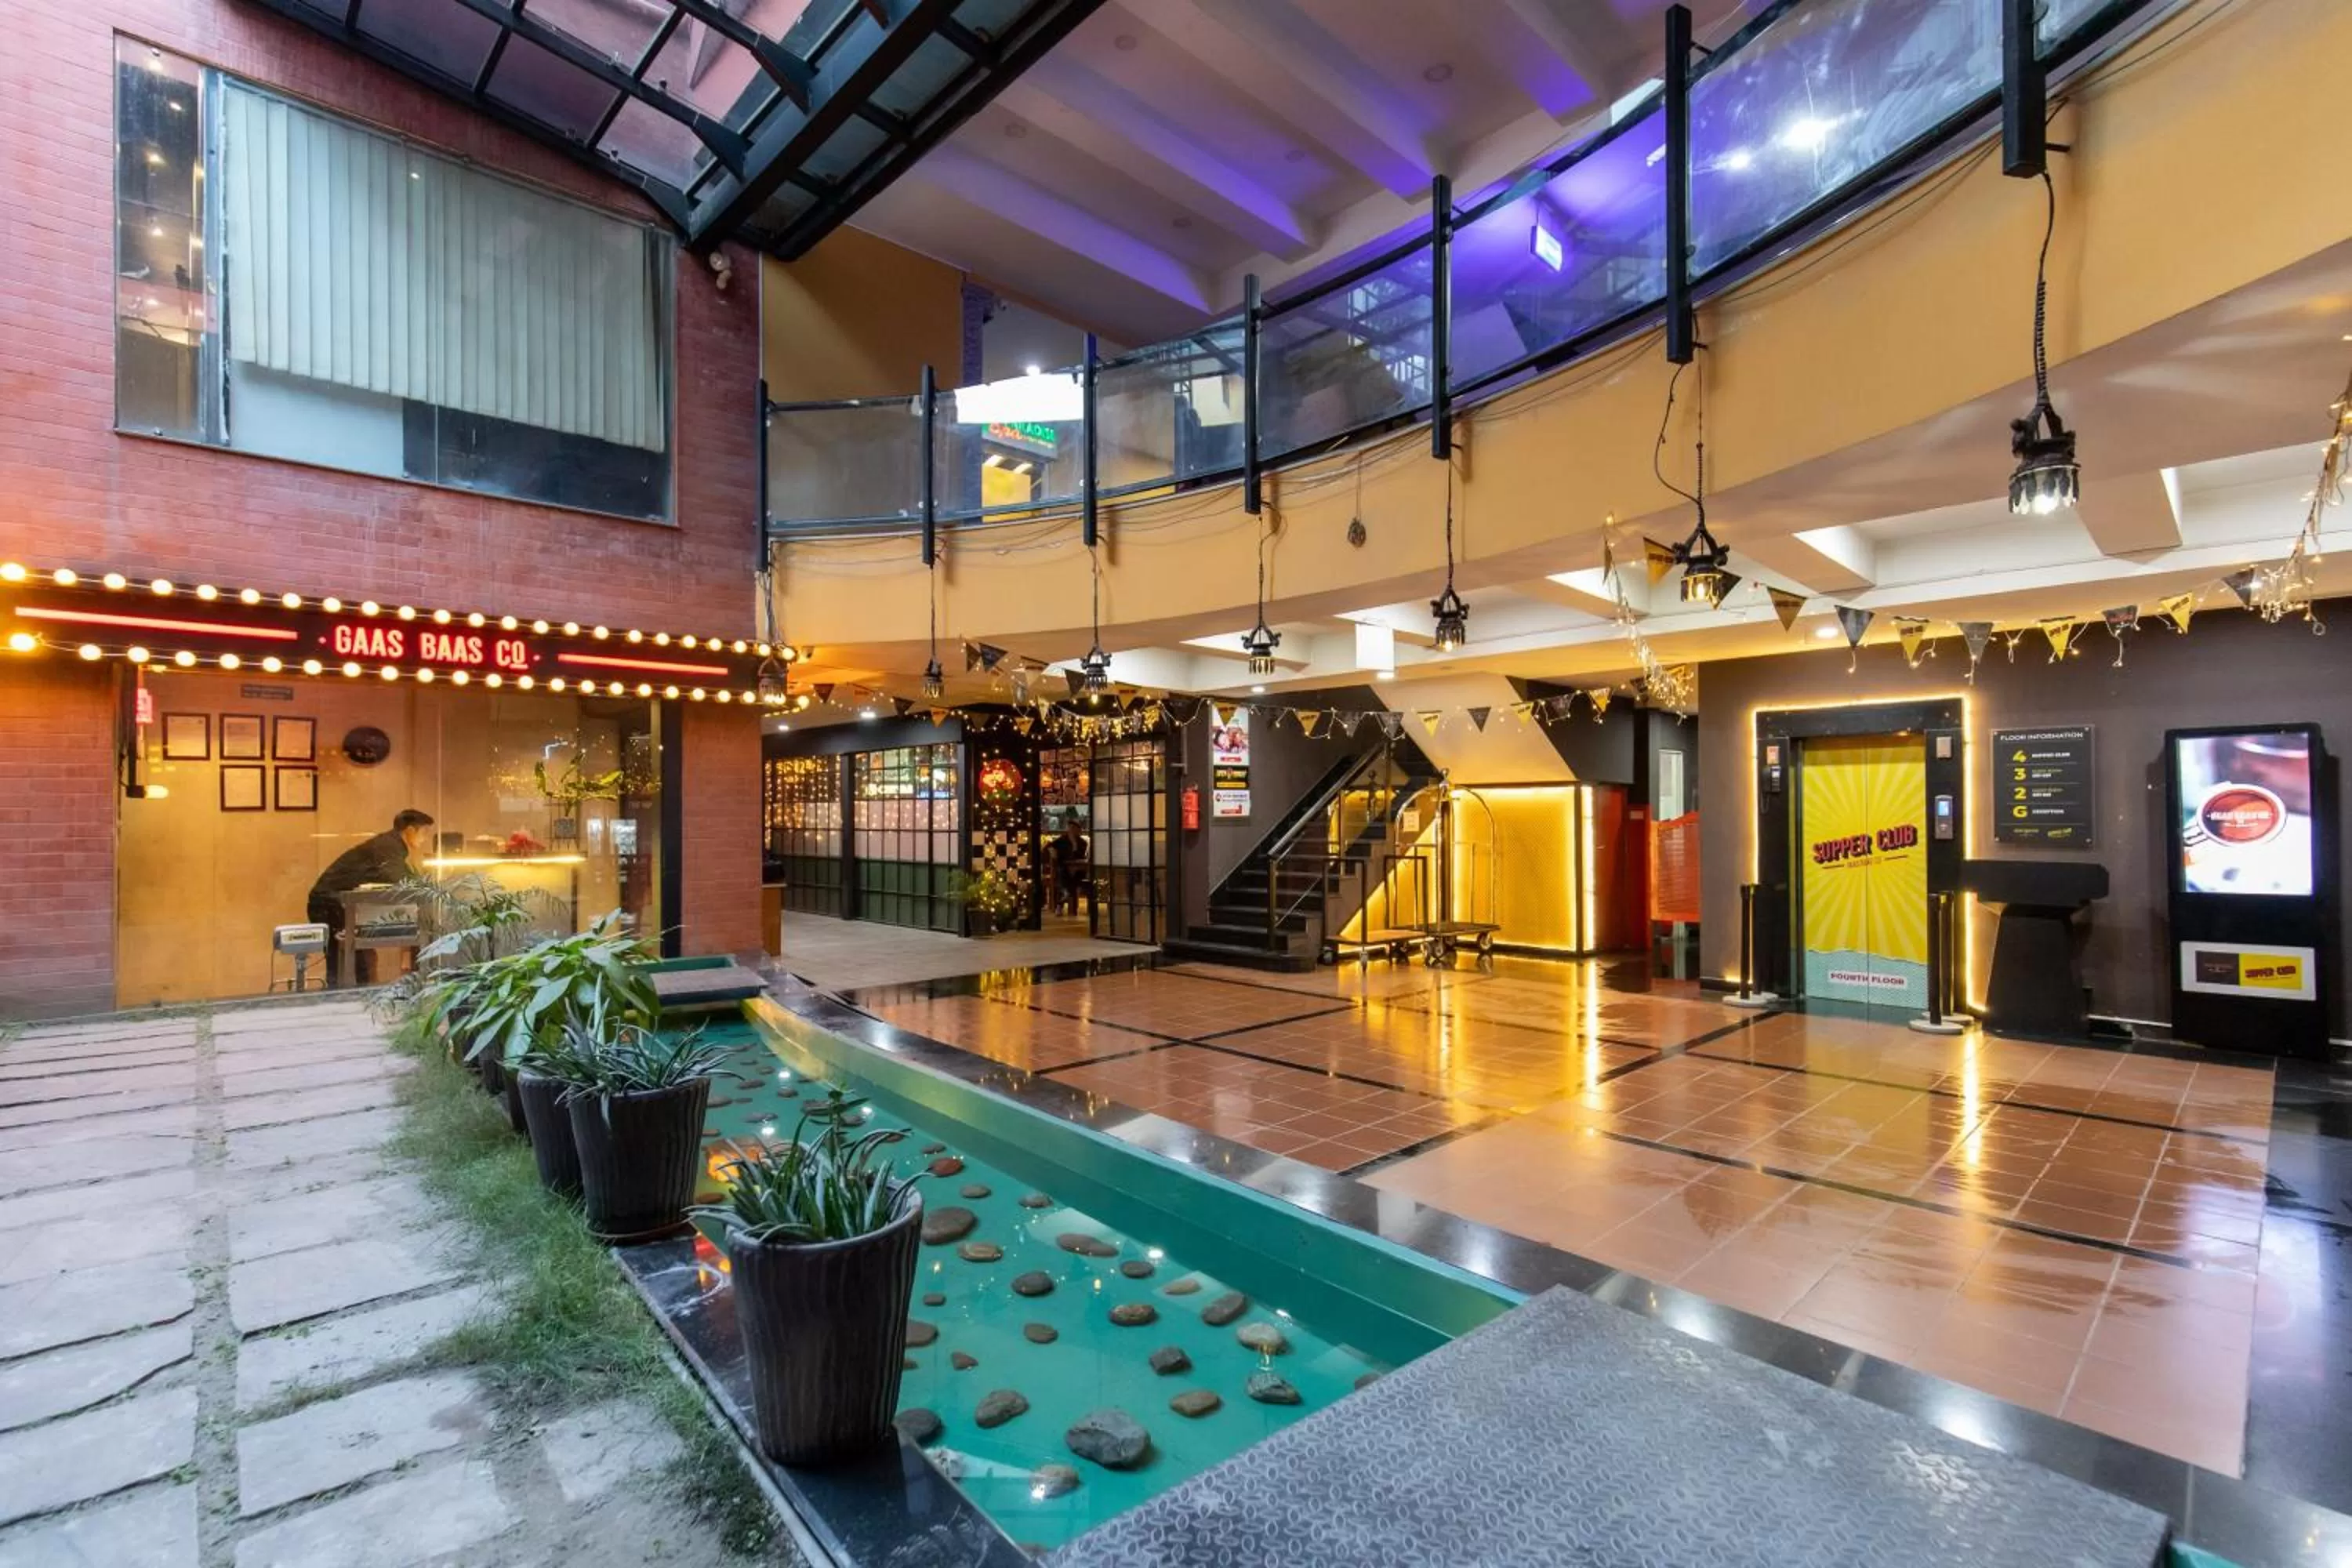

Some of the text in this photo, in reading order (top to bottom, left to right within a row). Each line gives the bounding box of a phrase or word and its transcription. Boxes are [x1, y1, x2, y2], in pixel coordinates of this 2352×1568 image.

[335, 625, 404, 659] GAAS
[420, 632, 483, 664] BAAS
[2027, 731, 2084, 741] INFORMATION
[2013, 750, 2027, 763] 4
[2013, 768, 2027, 781] 3
[2013, 787, 2027, 800] 2
[2013, 805, 2027, 818] G
[1813, 833, 1872, 864] SUPPER
[1876, 824, 1918, 851] CLUB
[1830, 973, 1904, 985] FOURTH FLOOR
